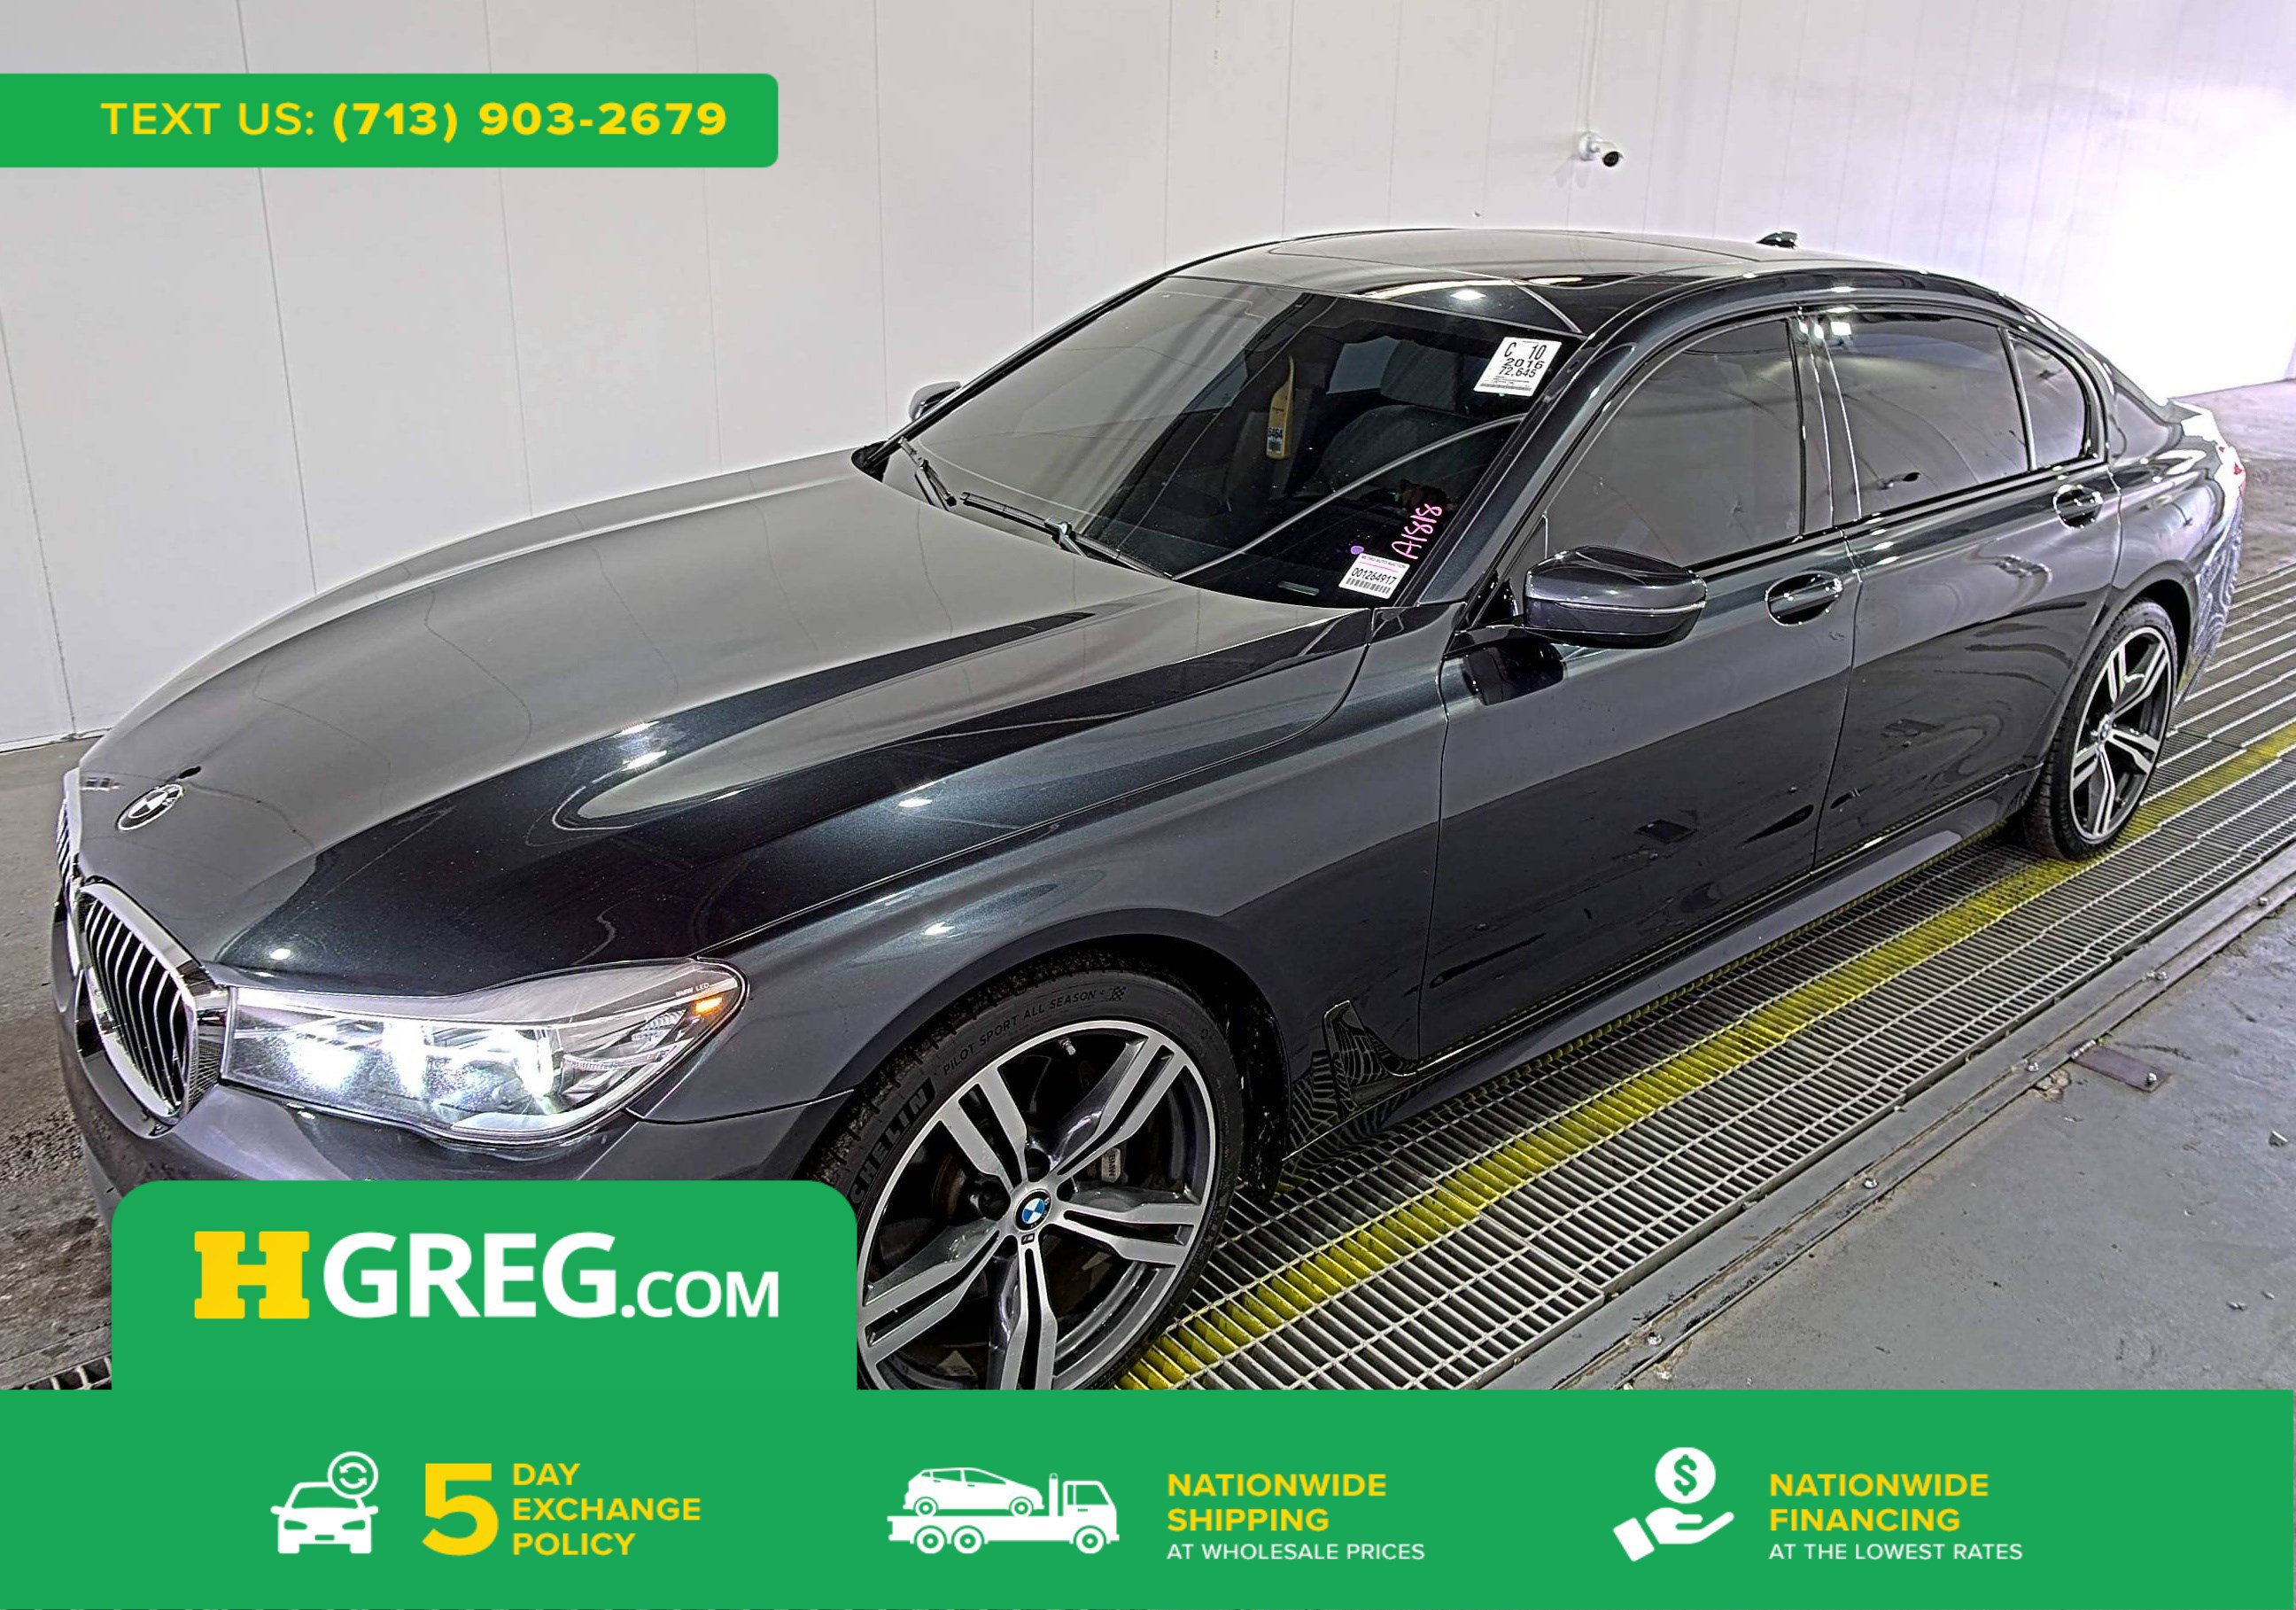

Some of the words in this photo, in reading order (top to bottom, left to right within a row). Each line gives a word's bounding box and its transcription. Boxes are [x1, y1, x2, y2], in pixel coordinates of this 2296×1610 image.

[1504, 341, 1517, 357] C
[1528, 345, 1547, 361] 10
[1503, 357, 1546, 369] 2016
[1351, 567, 1398, 586] 001264917
[695, 983, 710, 992] LED
[942, 1042, 974, 1076] PILOT
[979, 1015, 1019, 1046] SPORT
[1023, 1004, 1045, 1021] ALL
[1049, 990, 1097, 1010] SEASON
[849, 1086, 929, 1205] CHELIN
